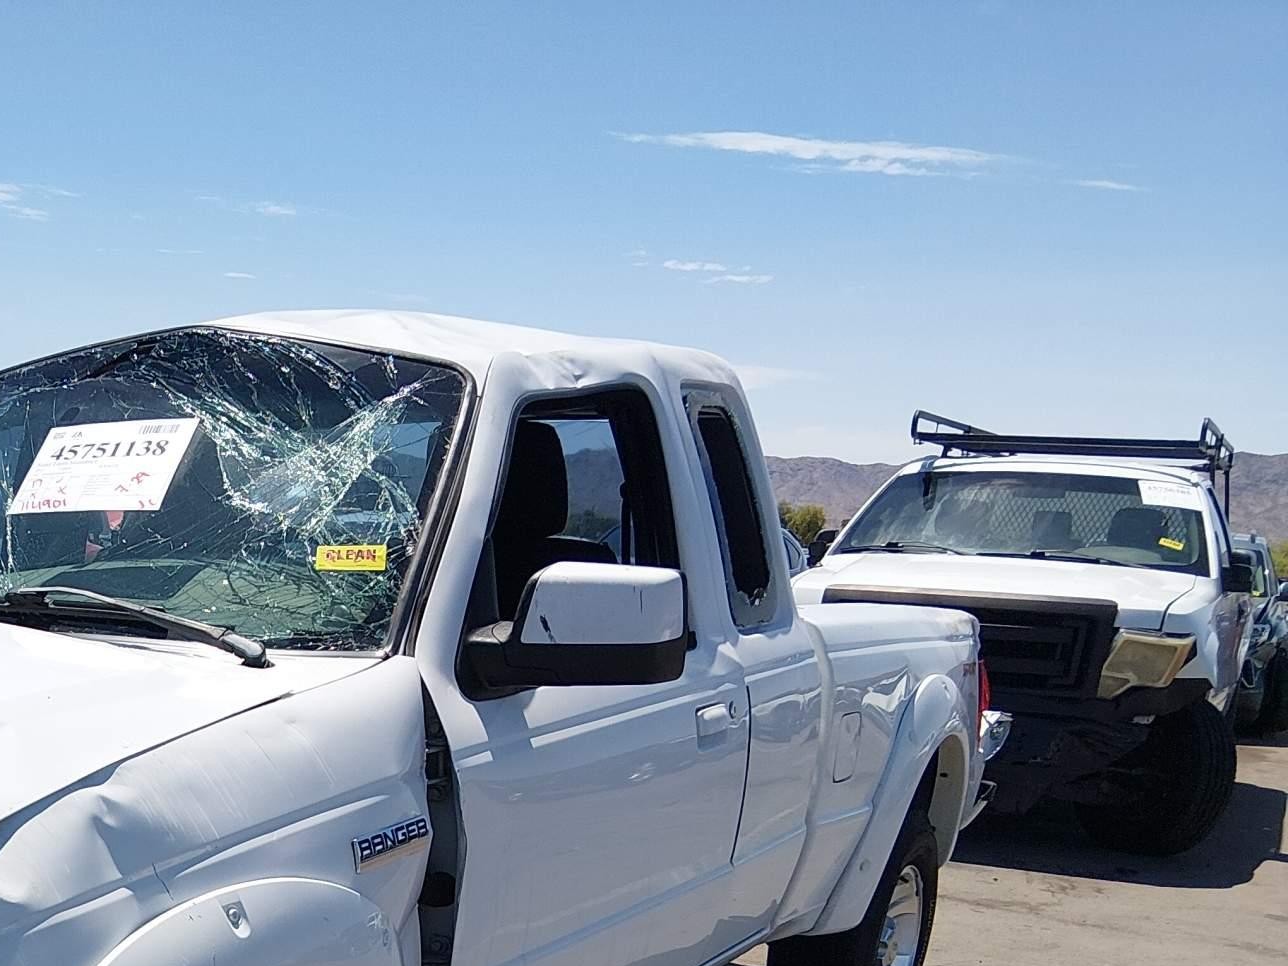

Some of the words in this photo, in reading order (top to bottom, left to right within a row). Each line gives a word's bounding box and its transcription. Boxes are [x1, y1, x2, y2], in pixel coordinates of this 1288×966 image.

[50, 440, 169, 461] 45751138
[326, 549, 376, 561] CLEAN
[357, 818, 429, 862] RANGER
